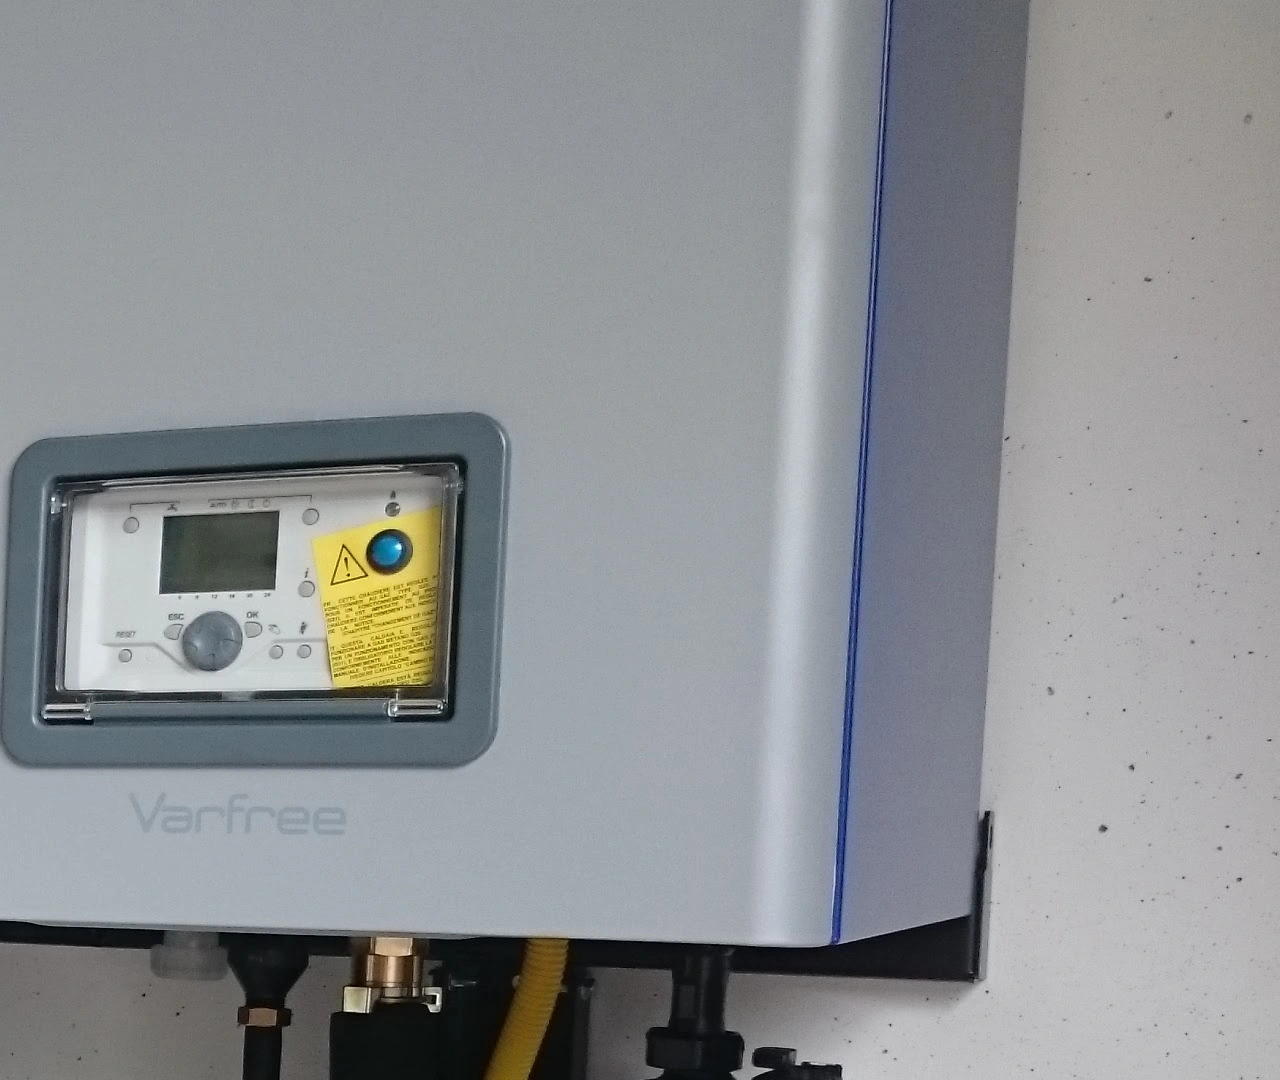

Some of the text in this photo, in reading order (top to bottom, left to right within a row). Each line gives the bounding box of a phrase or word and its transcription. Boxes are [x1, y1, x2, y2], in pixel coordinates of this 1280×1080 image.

[168, 613, 184, 621] ESC
[246, 611, 259, 619] OK
[115, 630, 136, 638] RESET
[128, 791, 346, 835] Varfree
